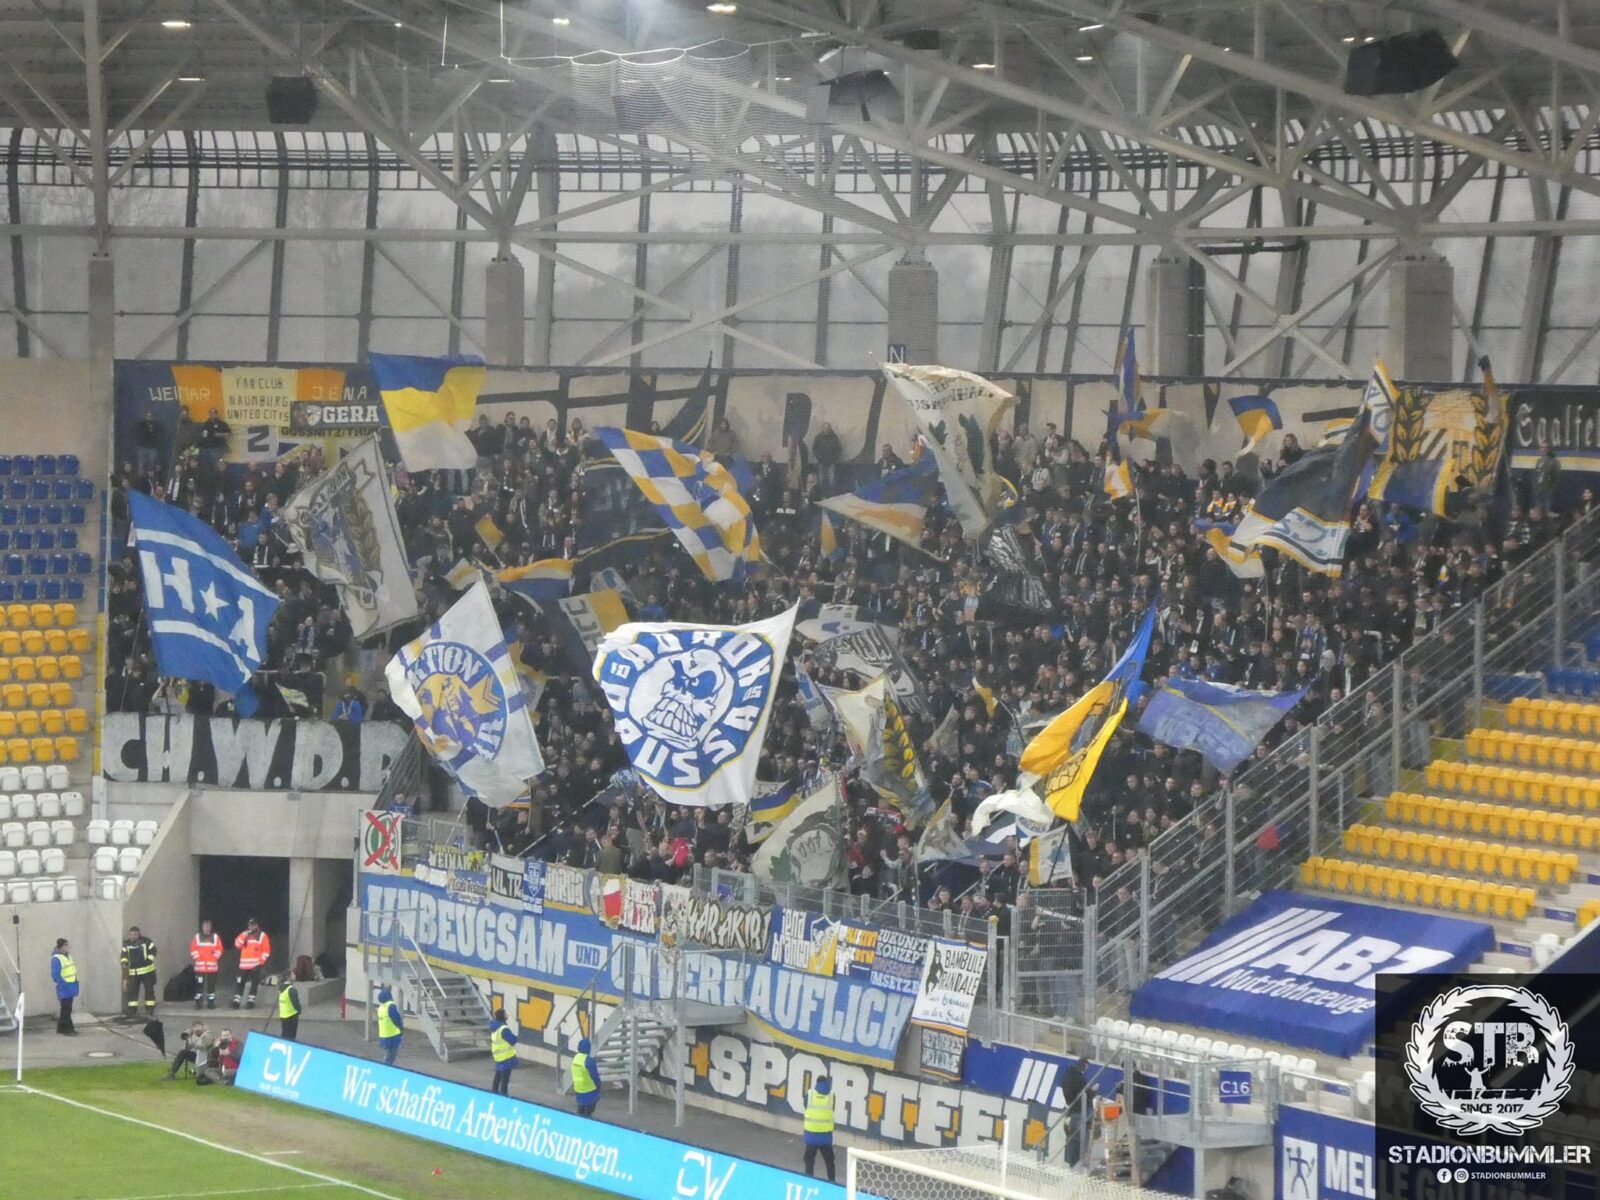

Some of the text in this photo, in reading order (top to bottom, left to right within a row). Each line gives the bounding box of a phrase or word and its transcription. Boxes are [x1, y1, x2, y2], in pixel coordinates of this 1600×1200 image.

[311, 385, 369, 402] JENA
[322, 404, 380, 424] GERA
[491, 867, 524, 899] ULTR
[574, 944, 601, 967] UND
[945, 949, 985, 974] BAMBULE
[1209, 969, 1376, 1015] Nutzfahrzeuge
[1220, 1081, 1250, 1094] C16
[343, 1065, 633, 1182] Wir schaffen Arbeitslösungen...
